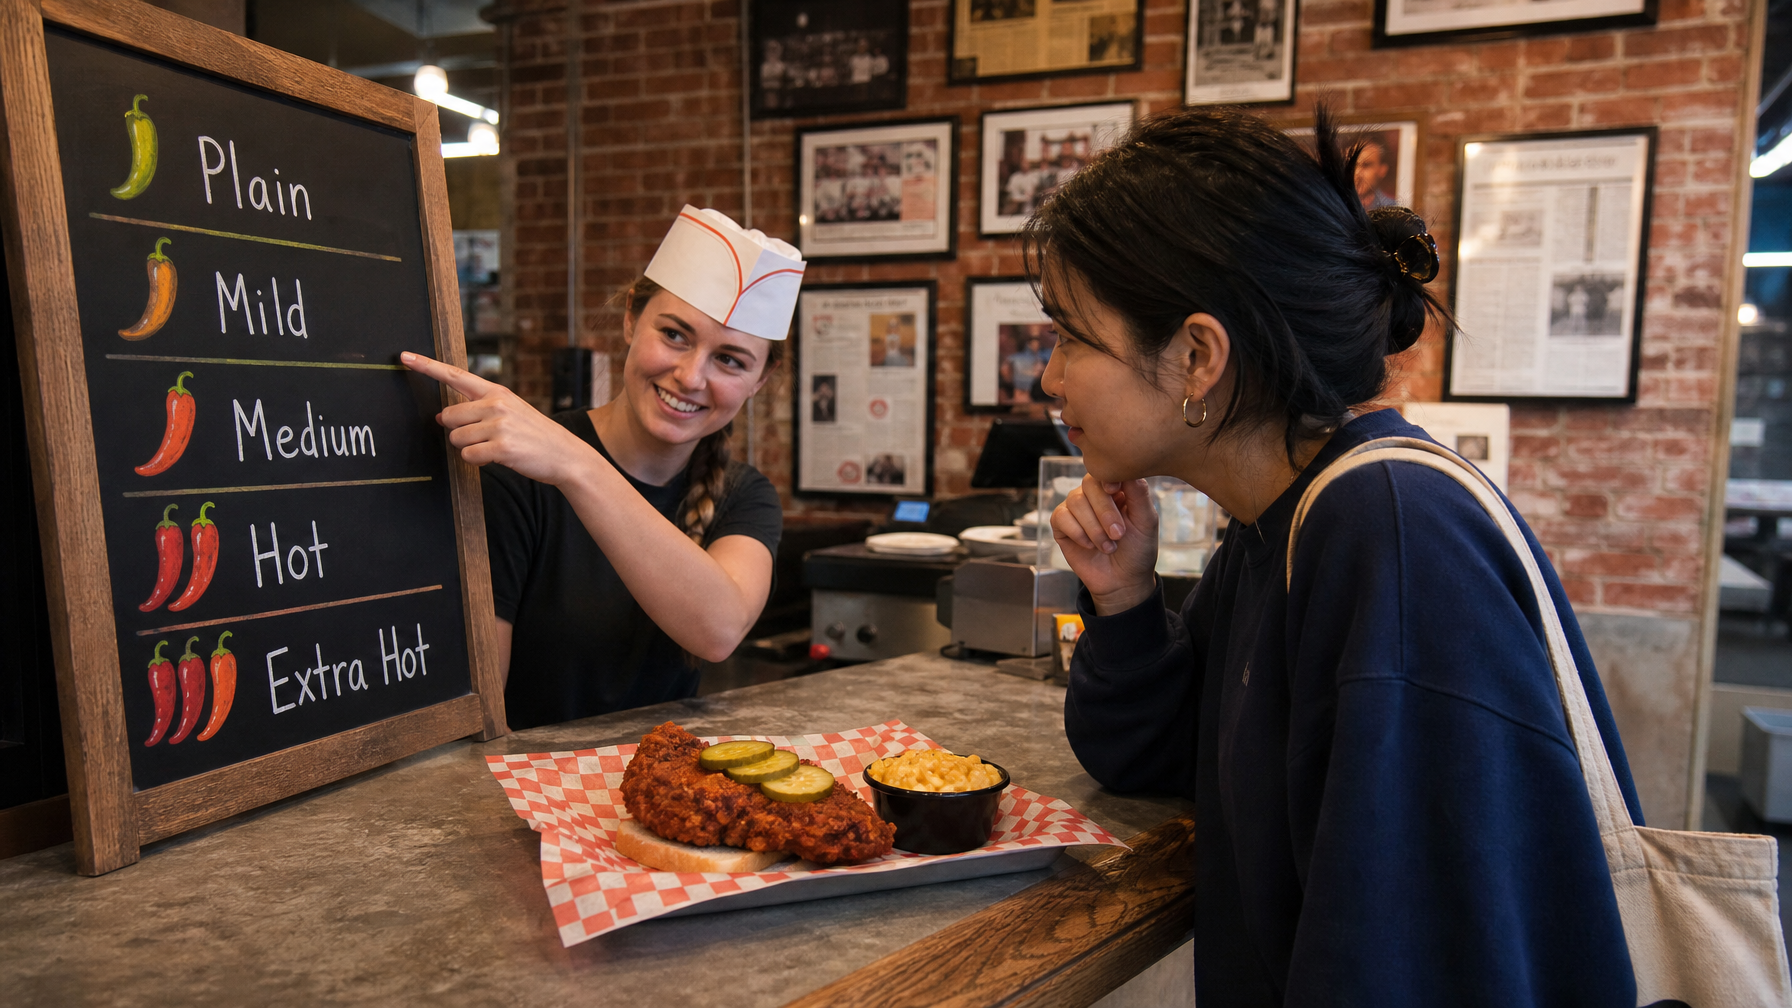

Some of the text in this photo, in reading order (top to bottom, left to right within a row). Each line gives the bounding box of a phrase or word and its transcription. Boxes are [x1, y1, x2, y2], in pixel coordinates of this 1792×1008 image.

[198, 136, 312, 220] Plain
[216, 271, 308, 338] Mild
[233, 399, 377, 462] Medium
[250, 520, 329, 587] Hot
[266, 623, 430, 714] Extra Hot
